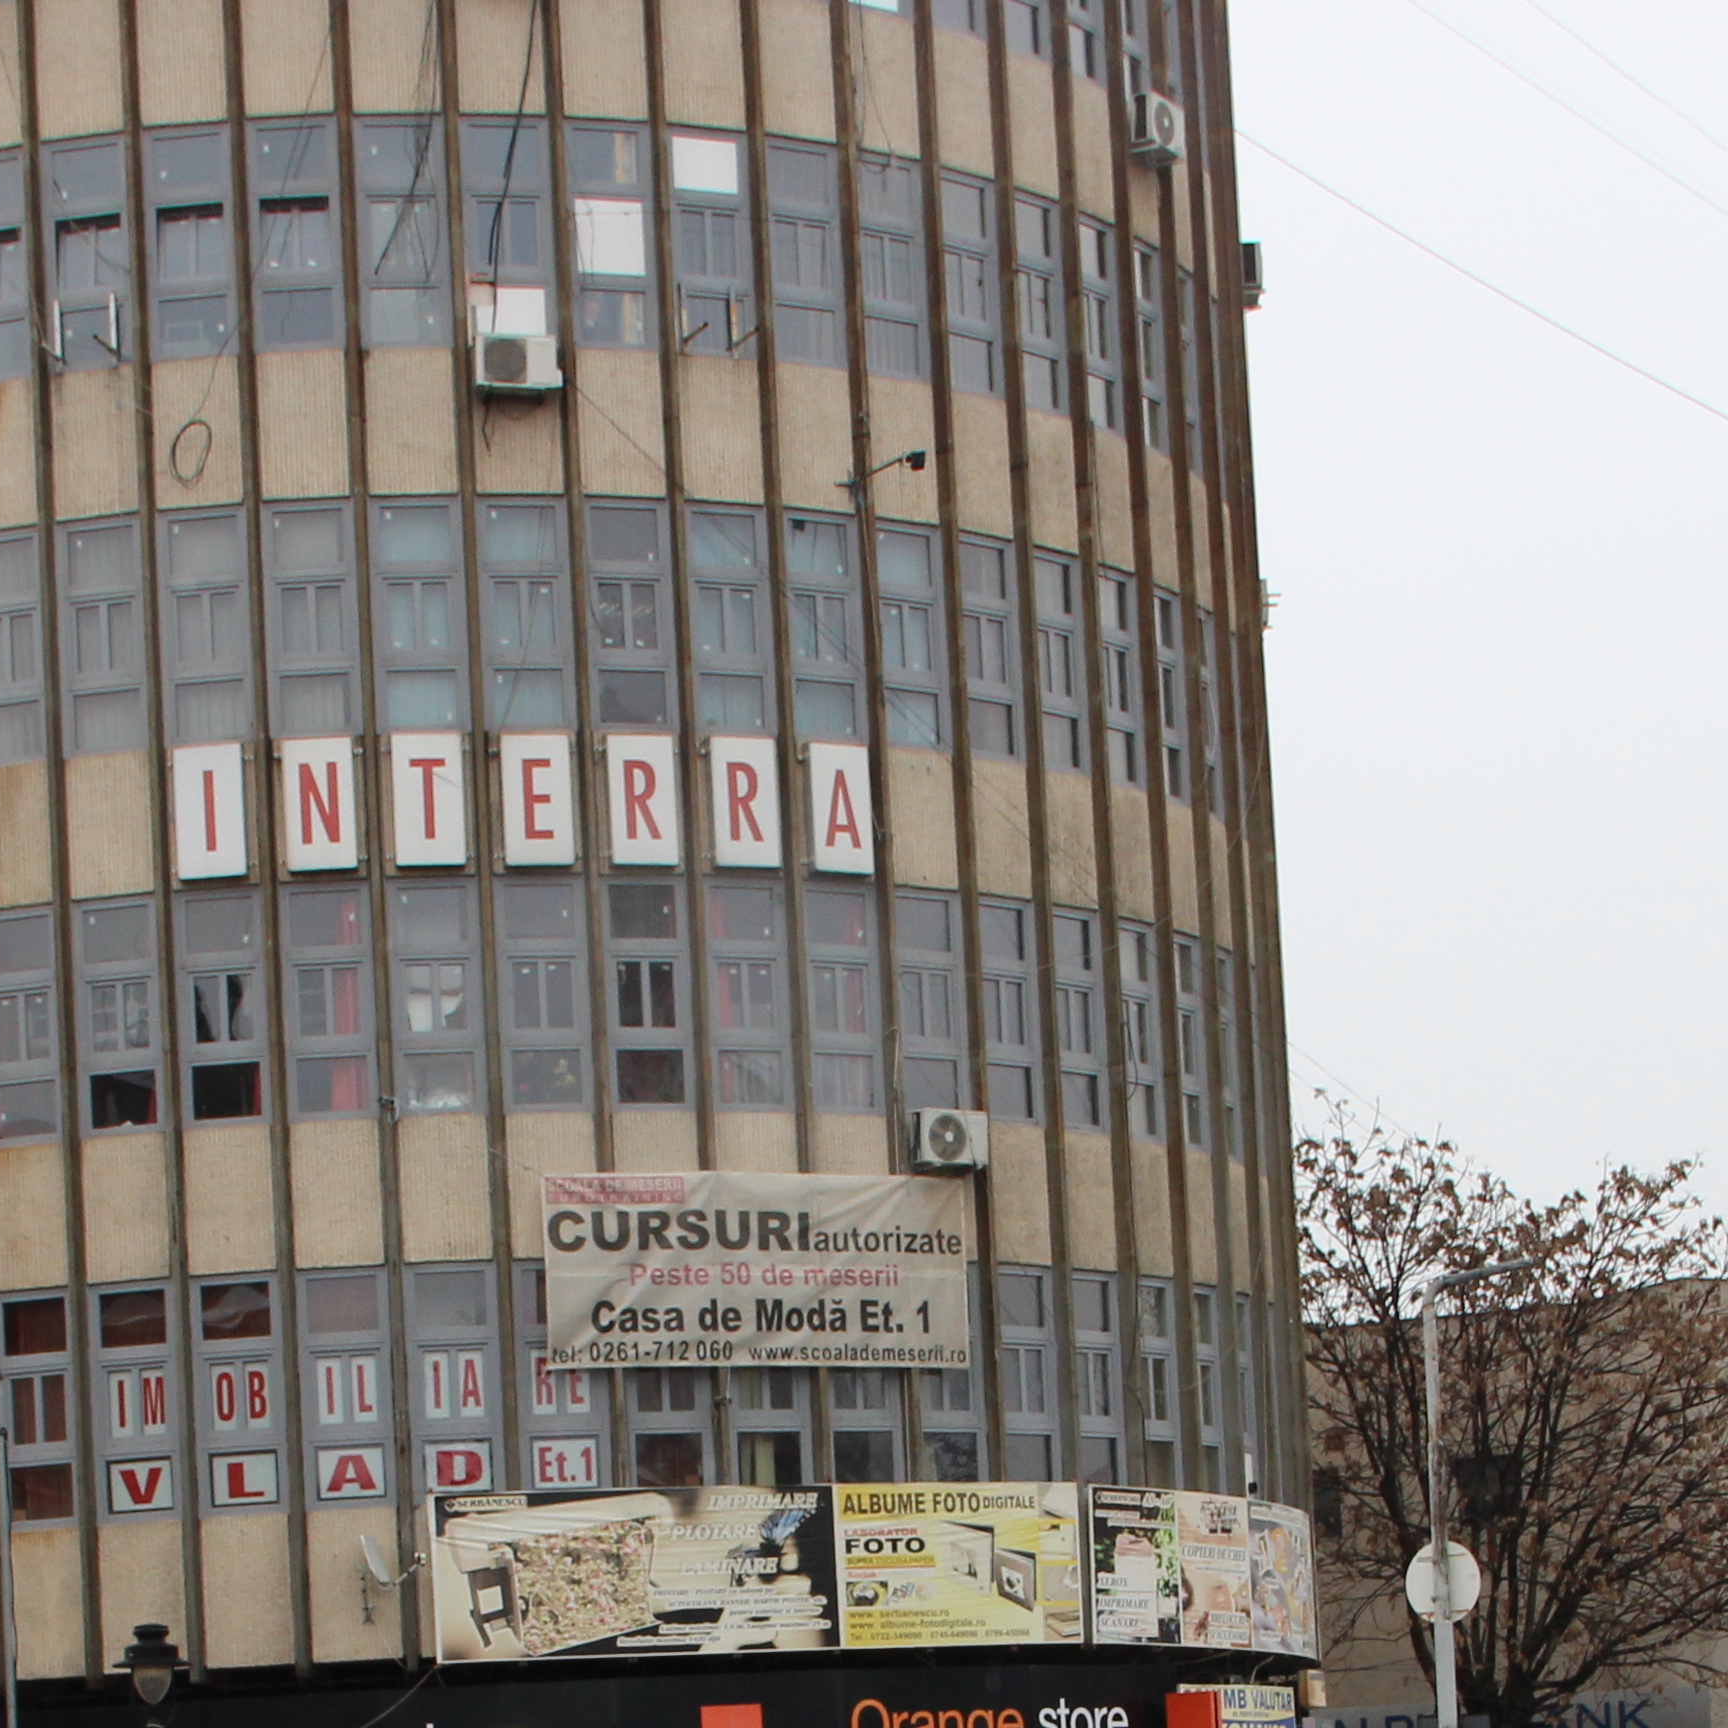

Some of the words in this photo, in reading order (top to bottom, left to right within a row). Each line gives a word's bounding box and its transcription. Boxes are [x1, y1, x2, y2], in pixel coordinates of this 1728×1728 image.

[202, 757, 862, 852] INTERRA
[547, 1209, 811, 1252] CURSURI
[814, 1225, 962, 1255] autorizate
[629, 1262, 709, 1287] Peste
[720, 1262, 751, 1285] 50
[761, 1263, 793, 1286] de
[804, 1263, 900, 1287] meserii
[591, 1300, 684, 1334] Casa
[698, 1299, 742, 1333] de
[756, 1298, 848, 1333] Modă
[860, 1301, 904, 1334] Et.
[916, 1301, 930, 1333] 1
[552, 1347, 582, 1364] tel:
[589, 1340, 690, 1363] 0261-712
[696, 1340, 734, 1361] 060
[748, 1344, 966, 1365] www.scoalademeserii.ro
[118, 1449, 483, 1505] VLAD
[708, 1492, 819, 1511] IMPRIMARE
[843, 1492, 926, 1515] ALBUME
[932, 1492, 980, 1514] FOTO
[983, 1495, 1035, 1510] DIGITALE
[844, 1527, 918, 1538] LABORATOR
[845, 1537, 926, 1555] FOTO
